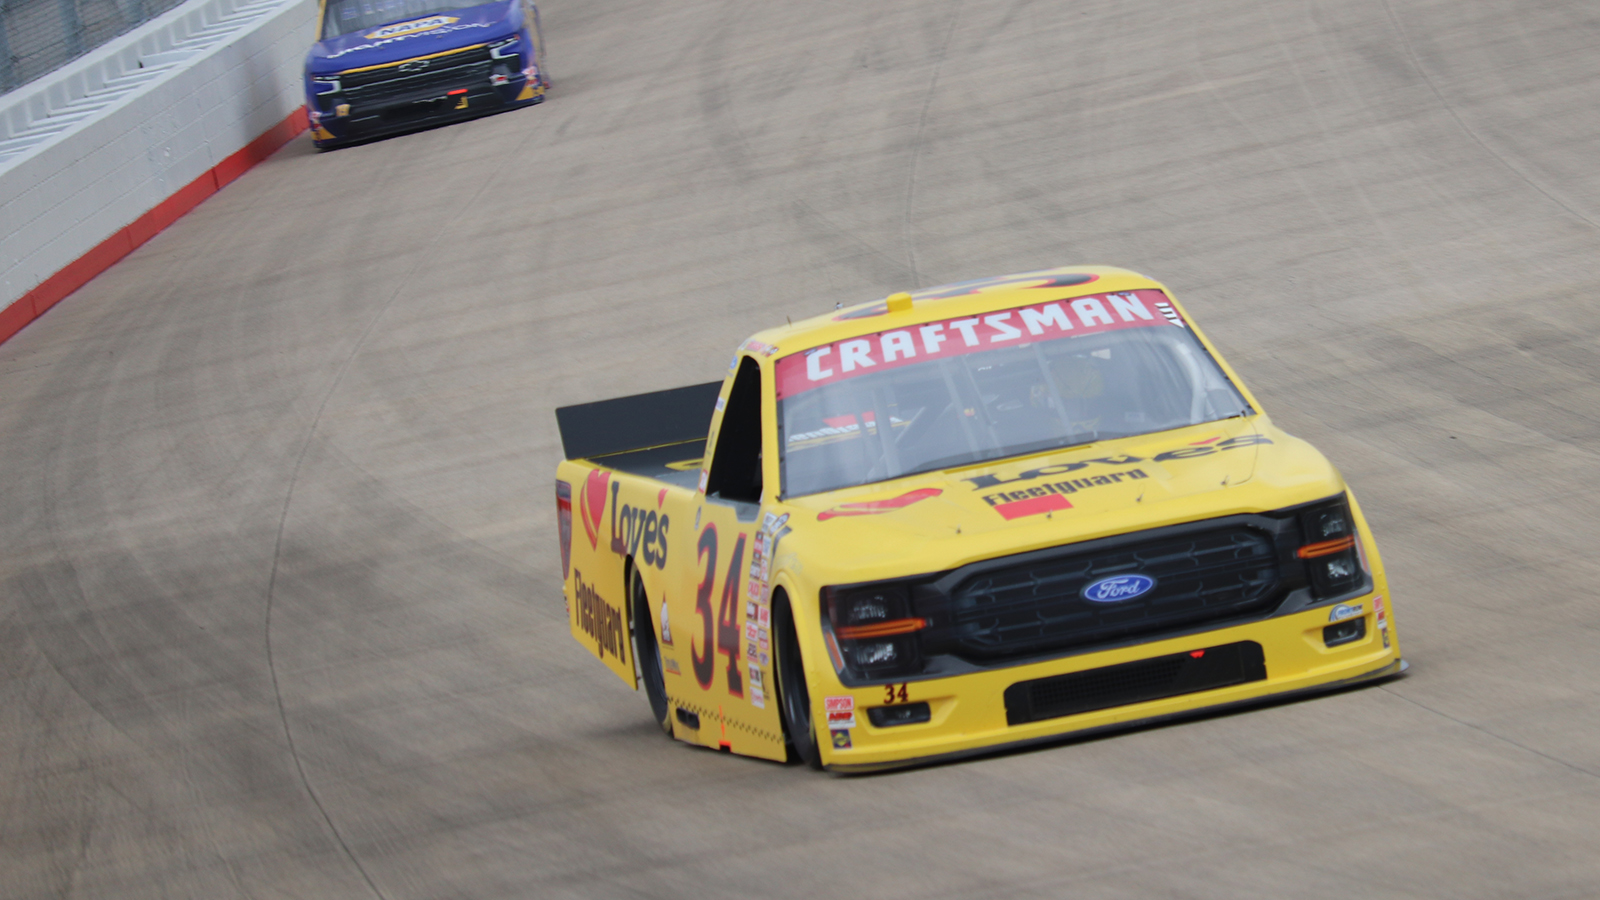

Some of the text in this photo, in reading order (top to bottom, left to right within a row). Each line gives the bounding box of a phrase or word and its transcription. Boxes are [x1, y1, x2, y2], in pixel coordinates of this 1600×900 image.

[379, 19, 443, 36] NAPA
[806, 292, 1154, 382] CRAFTSMAN
[981, 468, 1149, 508] Fleetguard
[611, 481, 669, 571] Love's
[573, 567, 626, 665] Fleetguard
[691, 522, 745, 699] 34
[1097, 578, 1140, 599] Ford
[883, 682, 909, 705] 34
